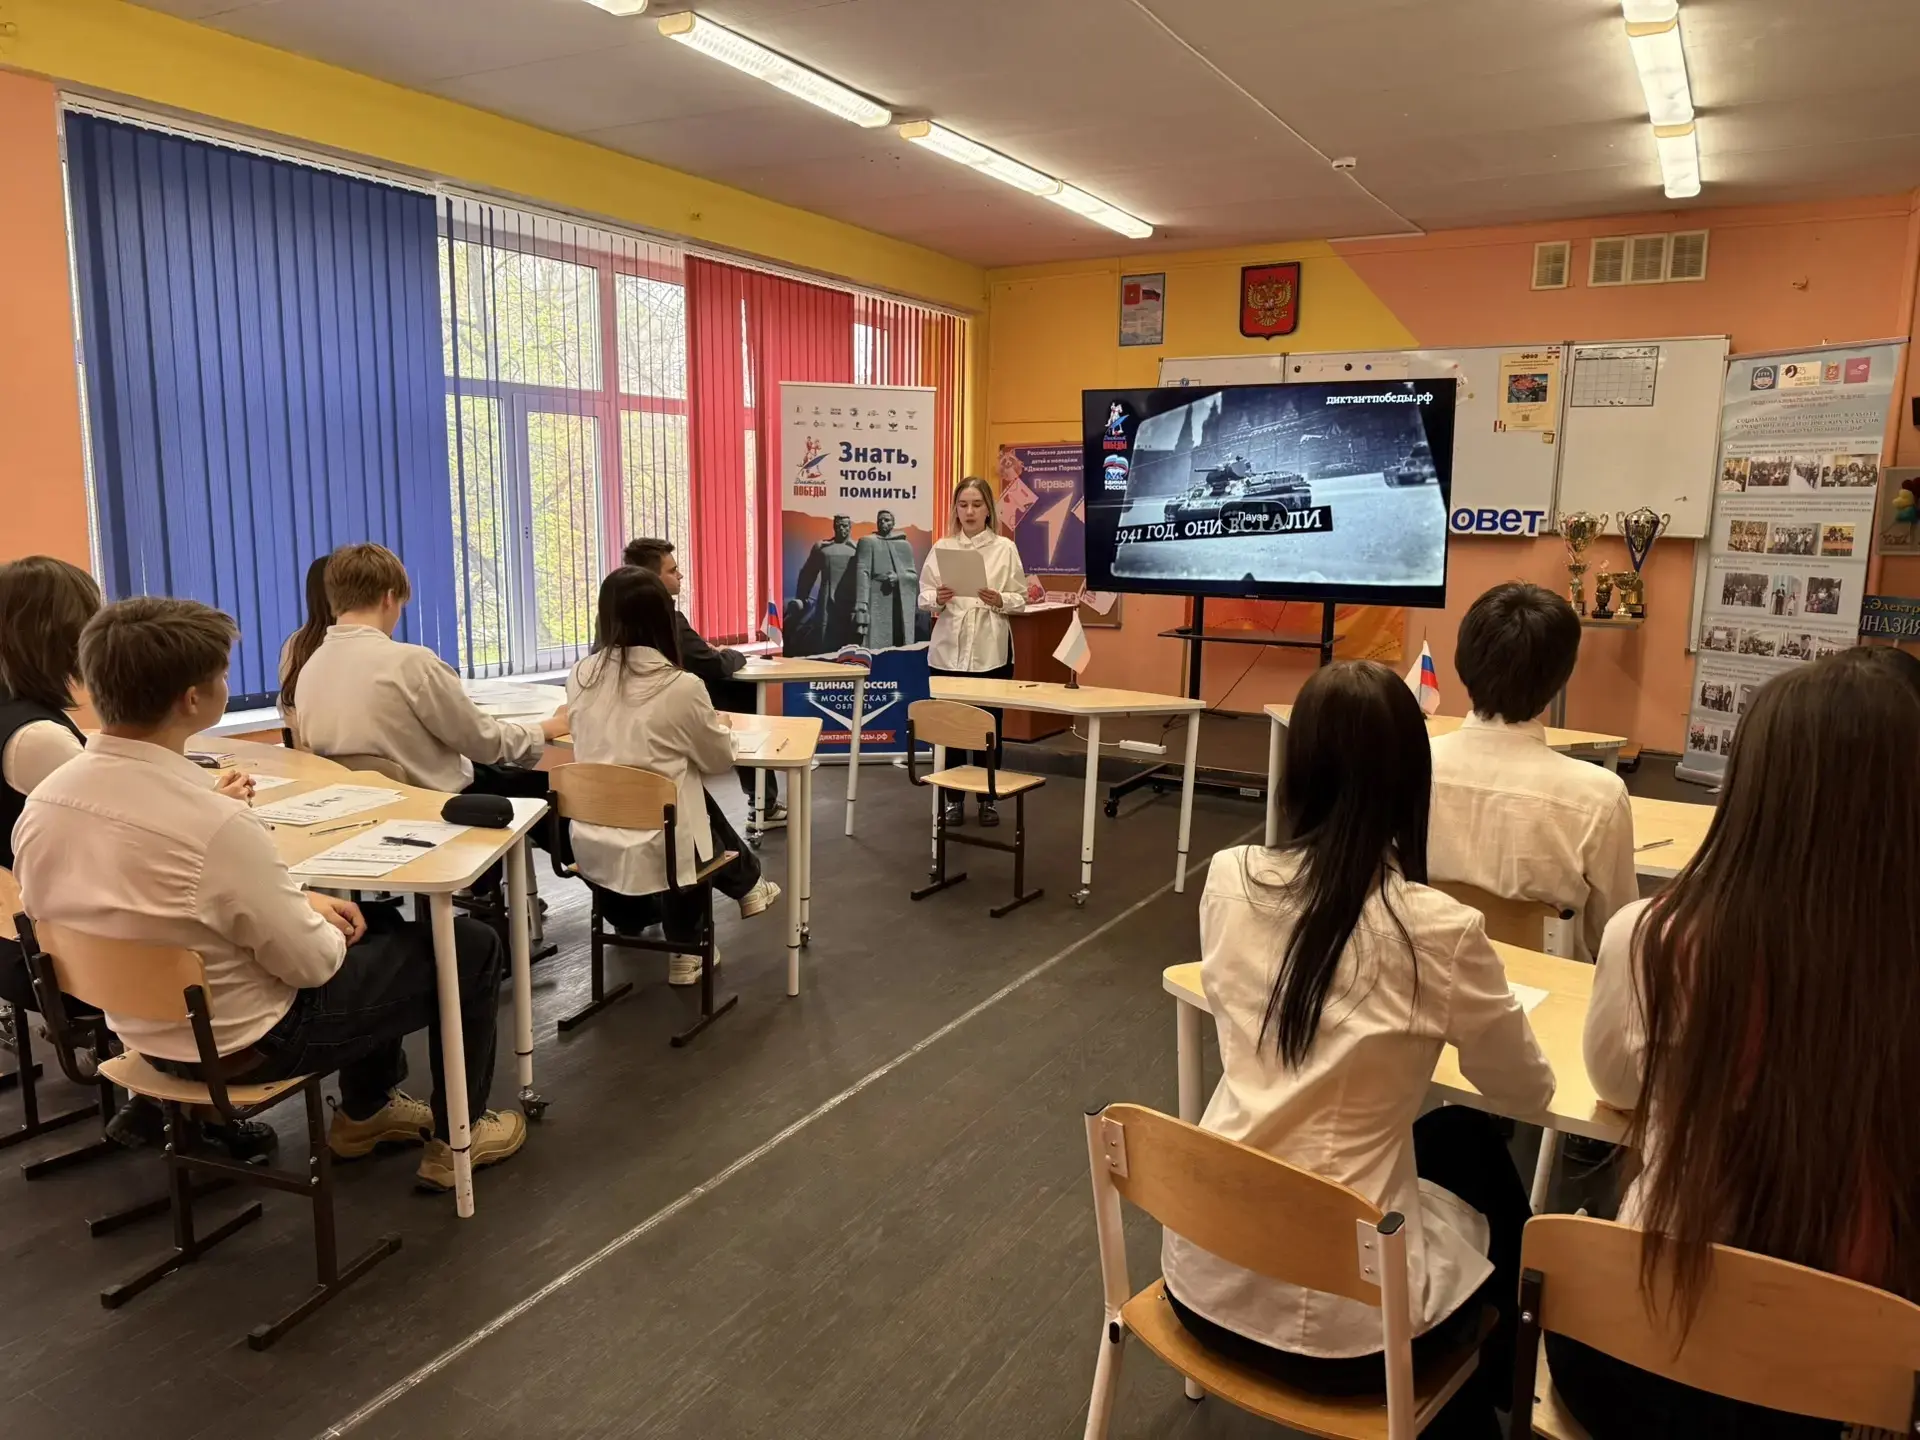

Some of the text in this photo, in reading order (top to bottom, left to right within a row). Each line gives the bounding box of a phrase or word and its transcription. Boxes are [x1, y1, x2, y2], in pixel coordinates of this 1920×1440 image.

[1326, 391, 1434, 405] диктантпобеды.рф
[838, 441, 918, 468] Знать,
[839, 467, 891, 482] чтобы
[793, 485, 827, 498] ПОБЕДЫ
[839, 485, 917, 499] помнить!
[1033, 478, 1075, 493] Первые
[1239, 511, 1269, 523] Пауза
[1450, 507, 1545, 534] овет
[1115, 530, 1142, 545] 1941
[1146, 523, 1179, 541] ГОД.
[1184, 519, 1223, 536] ОНИ
[809, 681, 898, 690] ЕДИНАЯ ОССИЯ
[820, 694, 887, 702] МОСКОСКАЯ
[819, 732, 888, 742] диктантпеды.рф
